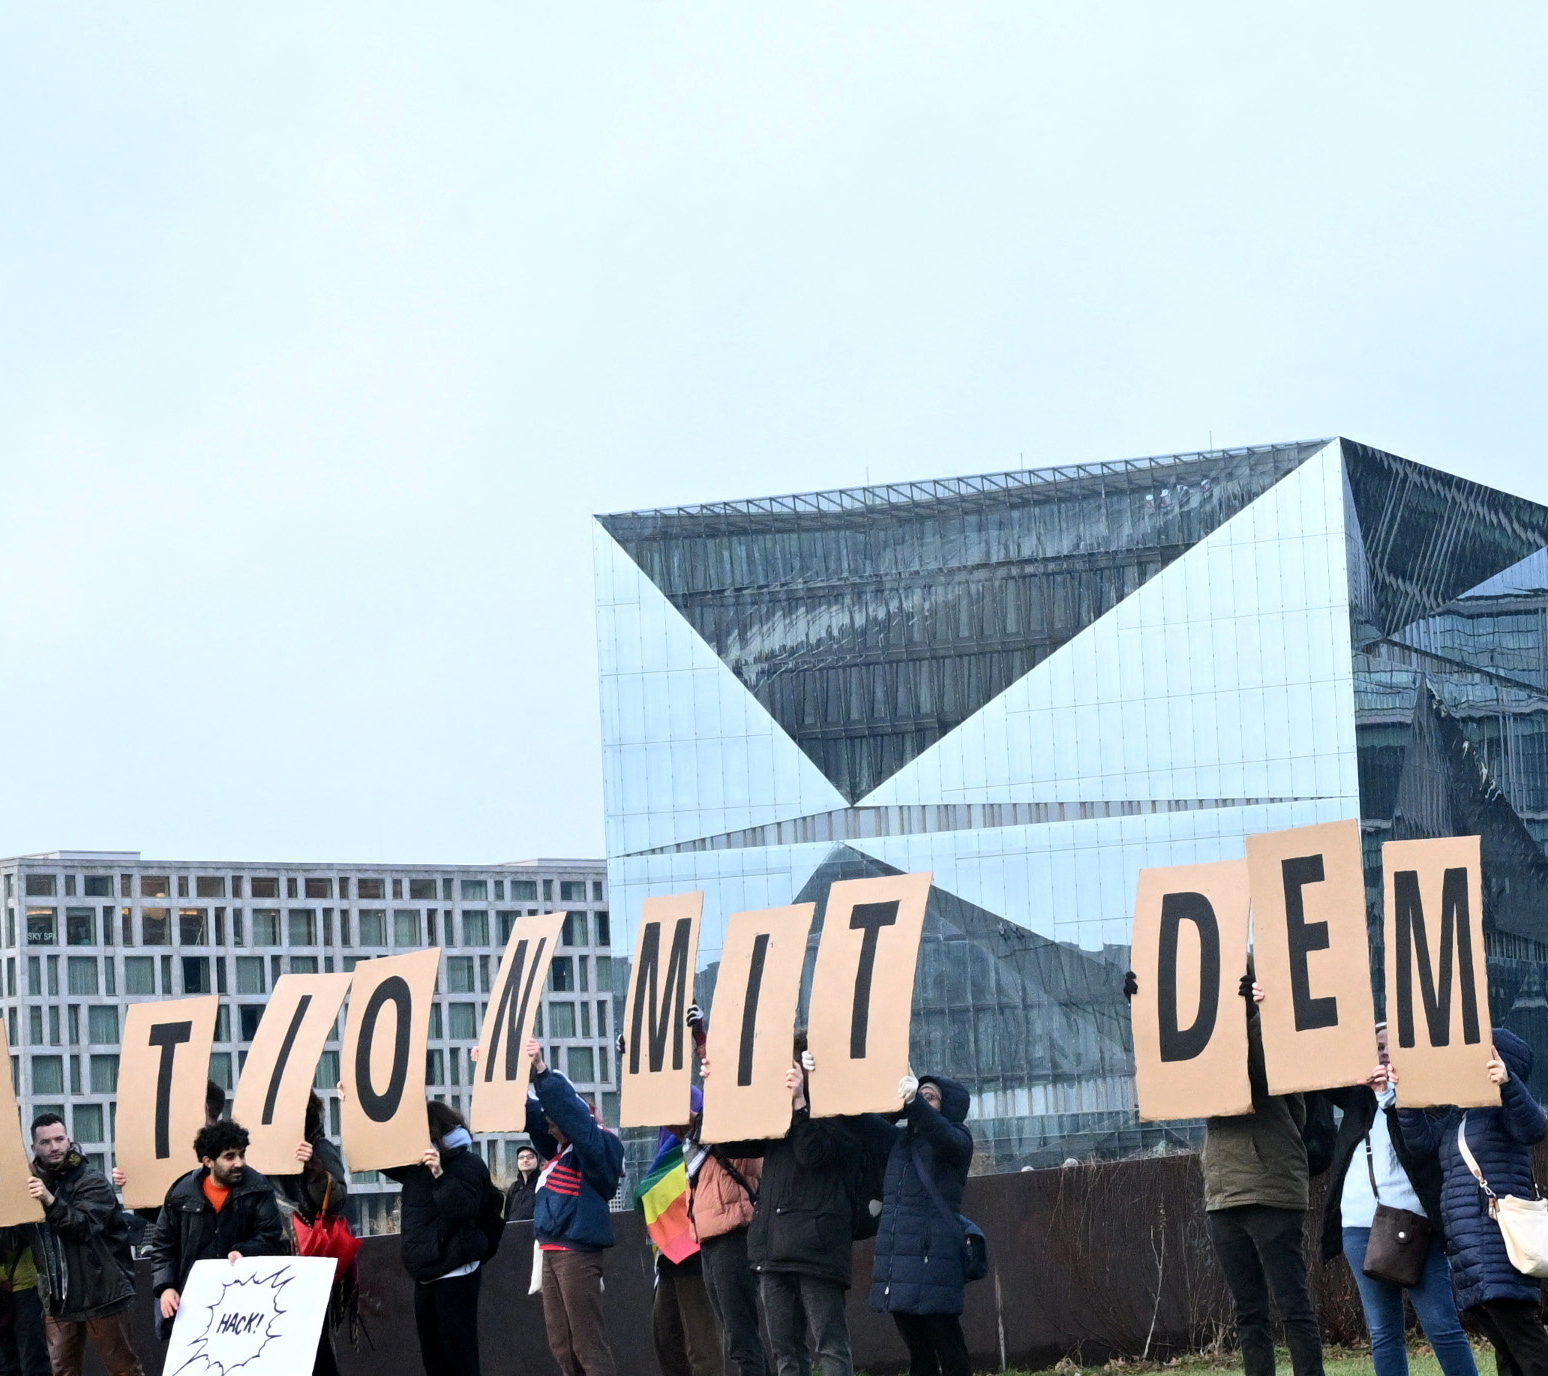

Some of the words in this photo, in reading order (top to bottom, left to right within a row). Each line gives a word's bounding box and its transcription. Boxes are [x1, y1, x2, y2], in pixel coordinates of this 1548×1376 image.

[27, 932, 41, 941] SKY
[628, 899, 900, 1088] MIT
[1156, 853, 1482, 1064] DEM
[216, 1311, 265, 1335] HACK!
